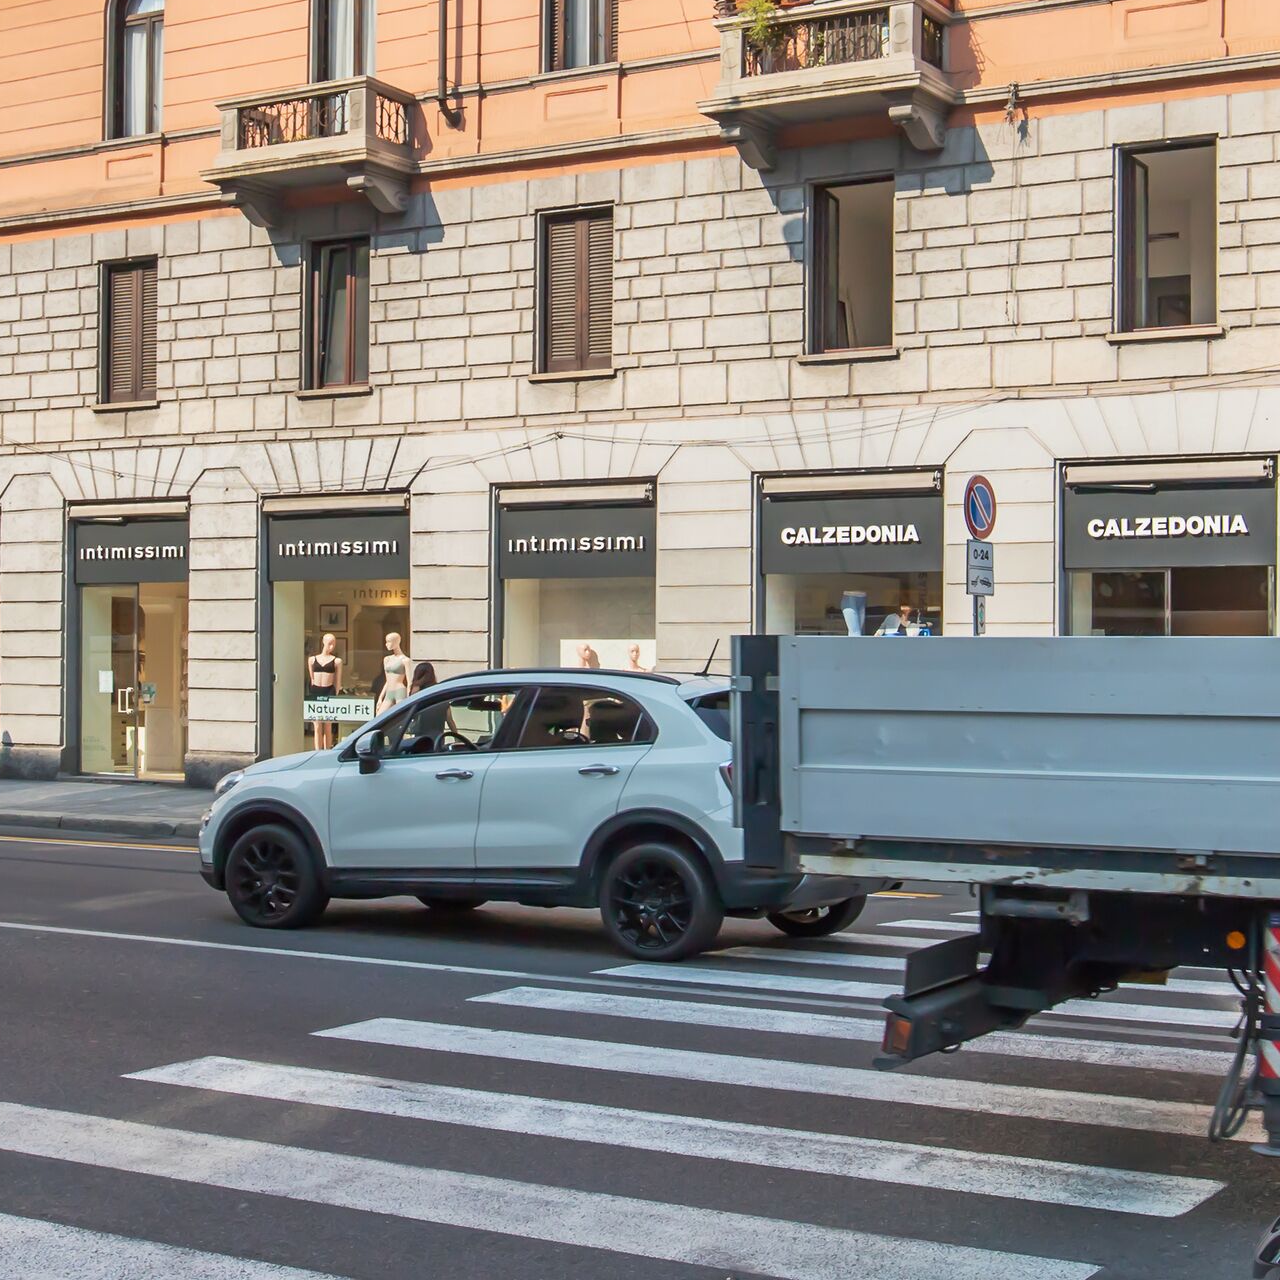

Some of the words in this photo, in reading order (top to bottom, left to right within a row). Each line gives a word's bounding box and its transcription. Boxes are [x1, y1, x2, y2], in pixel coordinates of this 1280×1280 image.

[780, 524, 920, 545] CALZEDONIA
[1087, 514, 1249, 538] CALZEDONIA
[80, 544, 185, 560] intimissimi
[278, 539, 398, 556] intimissimi
[508, 535, 644, 552] intimissimi
[973, 548, 989, 561] 0-24
[308, 704, 351, 714] Natural
[355, 704, 370, 715] Fit
